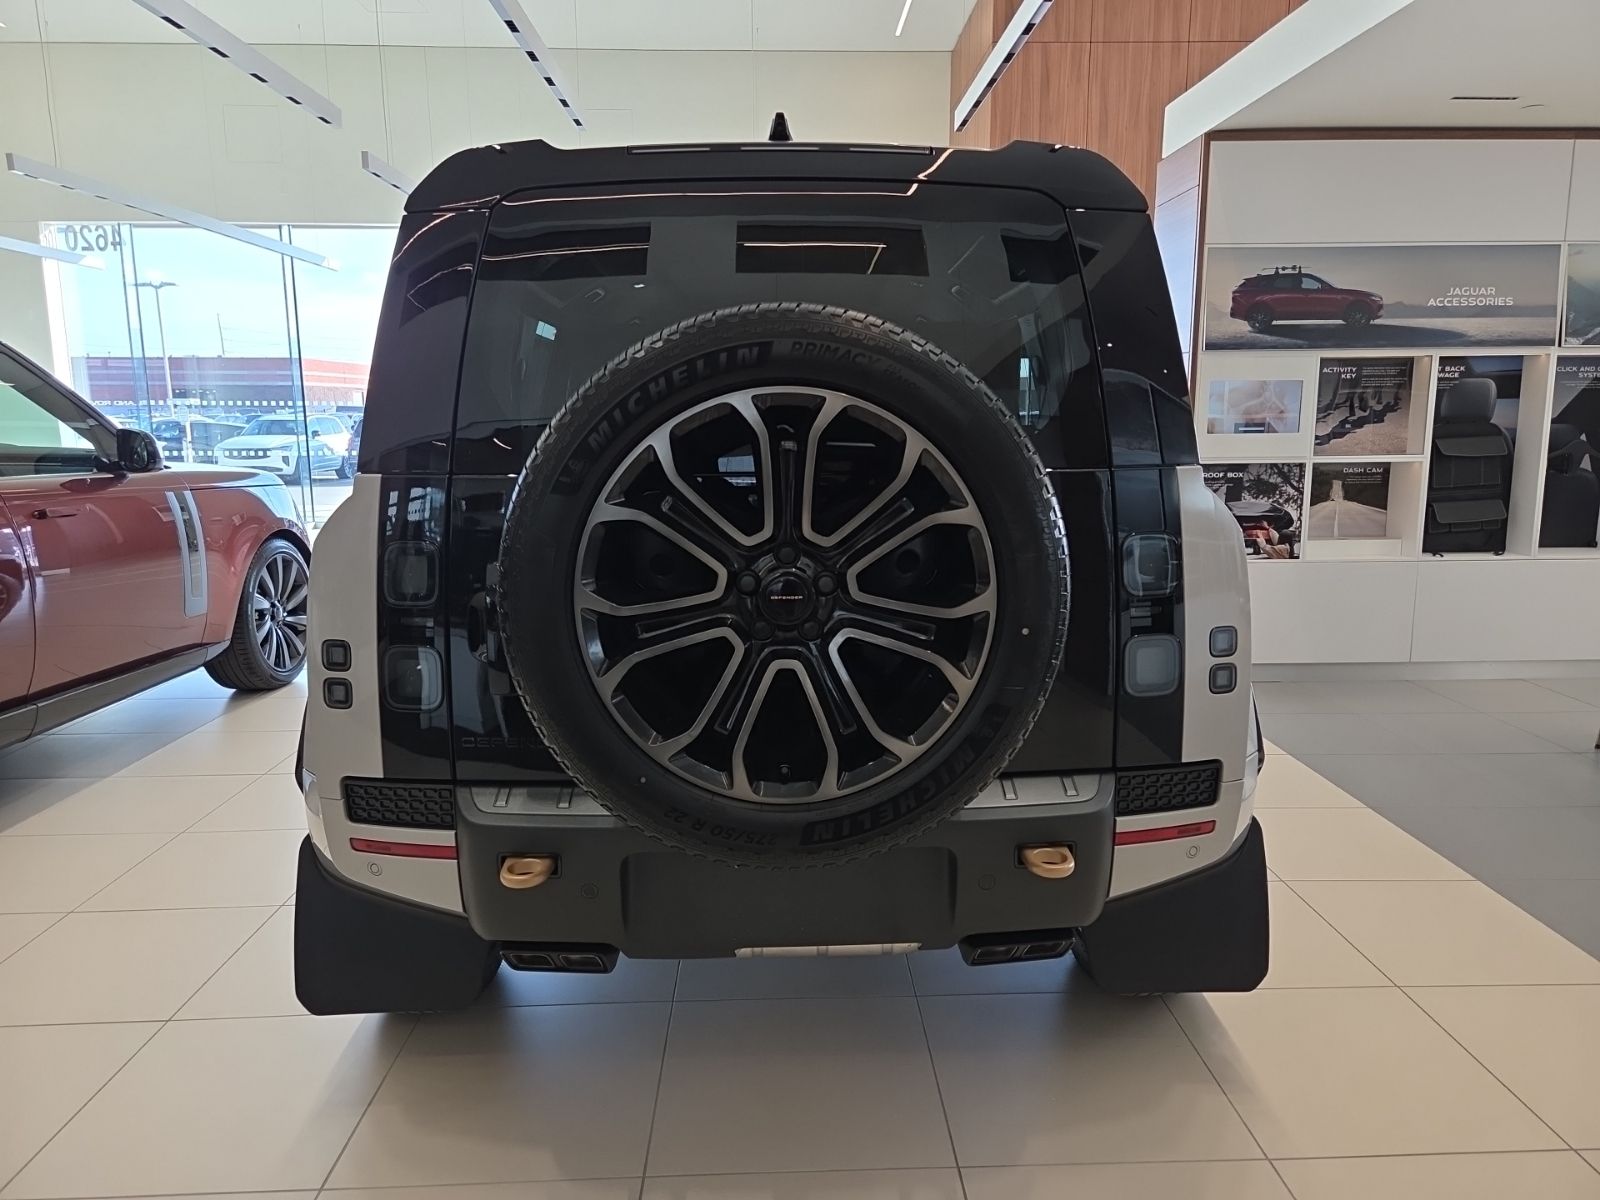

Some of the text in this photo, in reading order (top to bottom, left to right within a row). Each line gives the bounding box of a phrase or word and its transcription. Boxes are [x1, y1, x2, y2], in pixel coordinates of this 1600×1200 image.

[1446, 287, 1496, 296] JAGUAR
[1427, 297, 1514, 307] ACCESSORIES
[1322, 366, 1358, 374] ACTIVITY
[587, 341, 883, 452] MICHELIN PRIMACY
[462, 737, 543, 748] DEFEN
[813, 743, 977, 842] MICHELIN
[691, 819, 707, 832] R
